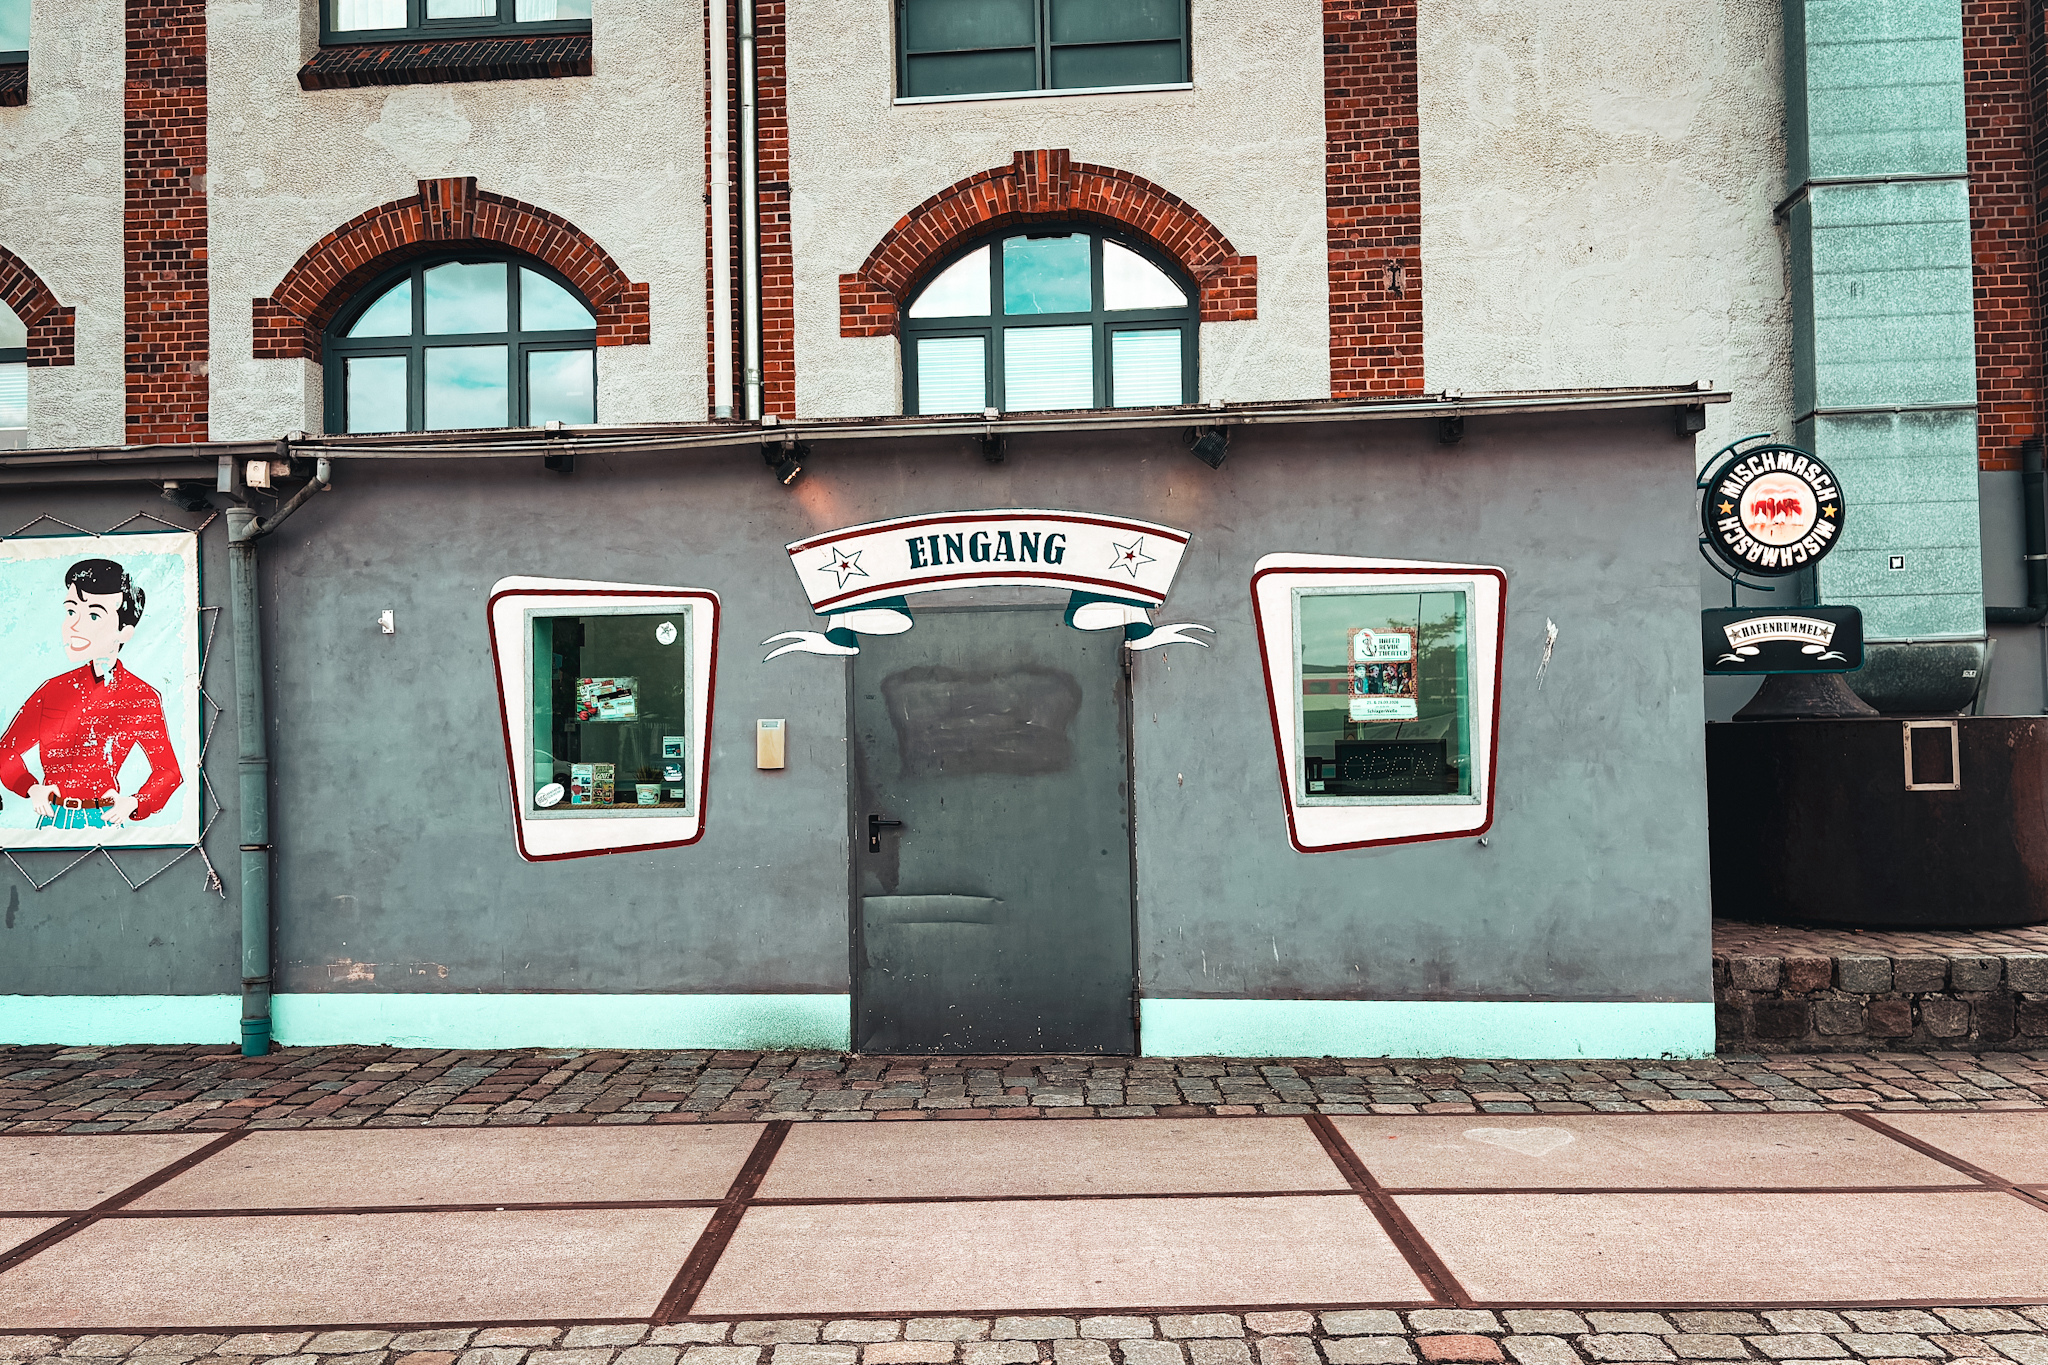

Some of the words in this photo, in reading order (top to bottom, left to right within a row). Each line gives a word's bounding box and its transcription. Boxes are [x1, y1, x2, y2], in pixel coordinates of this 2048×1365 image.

[1719, 451, 1838, 502] MISCHMASCH
[905, 530, 1067, 570] EINGANG
[1717, 516, 1837, 568] MISCHMASCH
[1741, 622, 1820, 637] HAFENRUMMEL
[1344, 755, 1439, 781] OPEN
